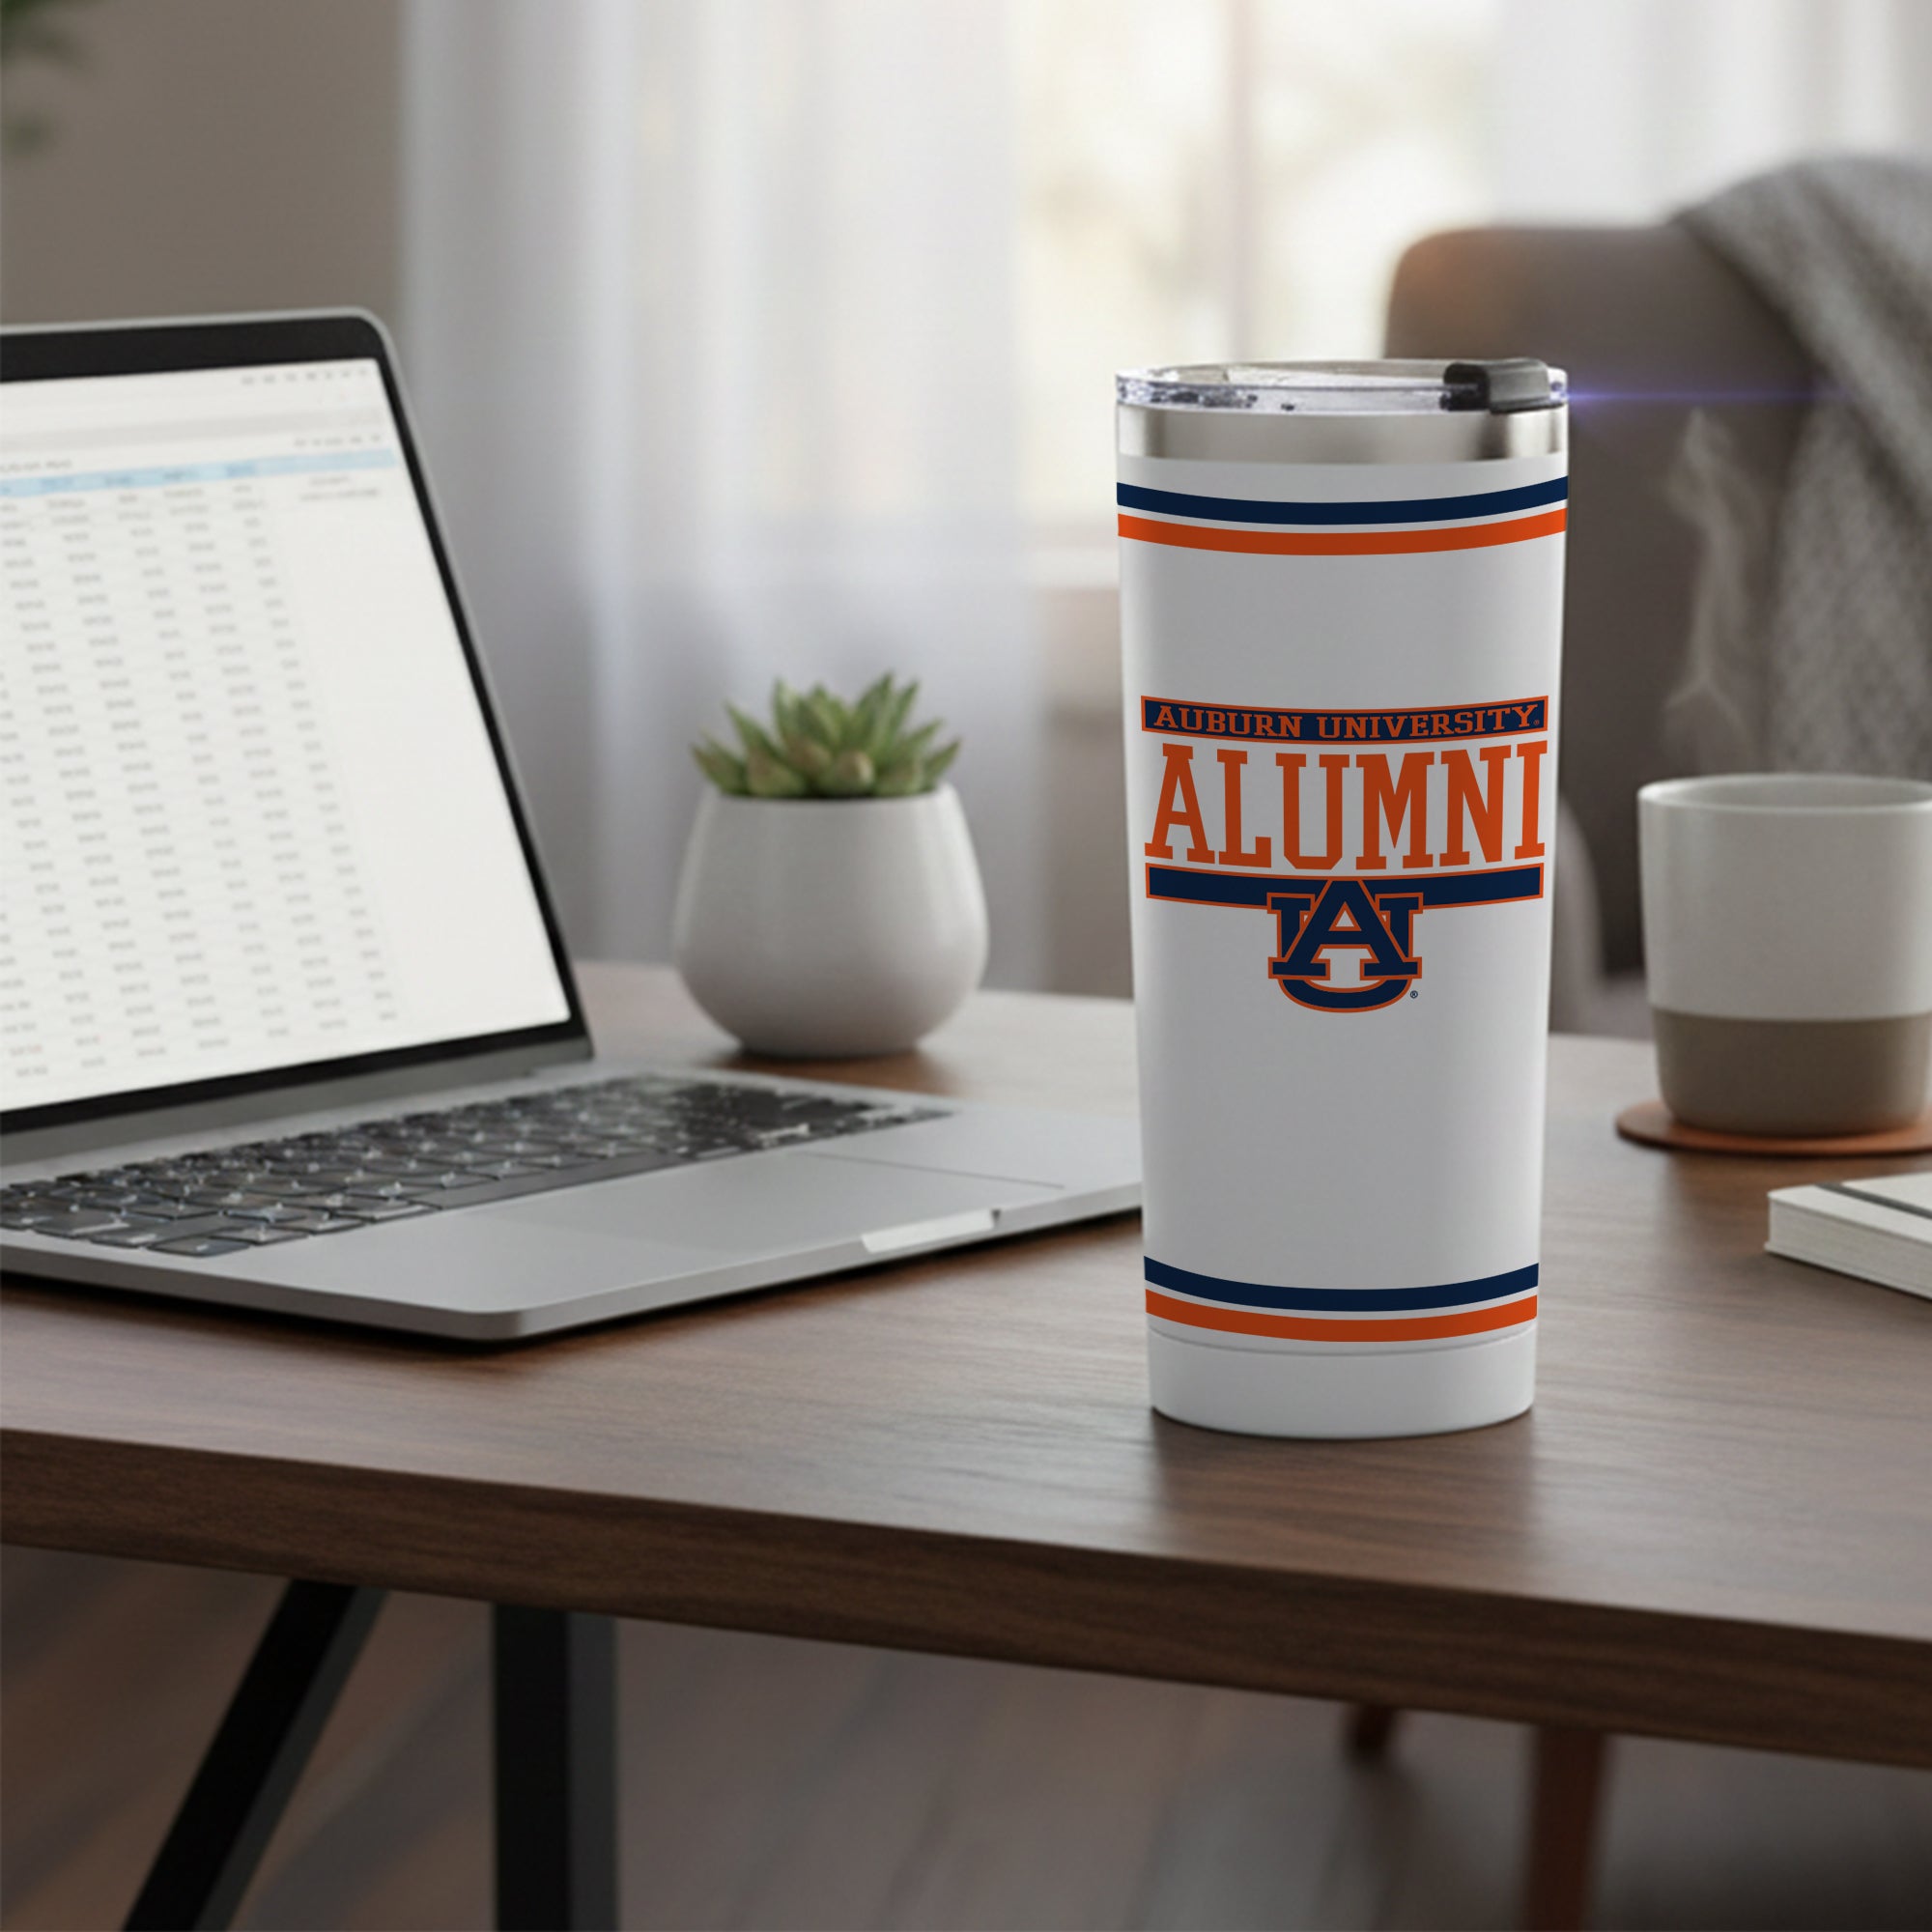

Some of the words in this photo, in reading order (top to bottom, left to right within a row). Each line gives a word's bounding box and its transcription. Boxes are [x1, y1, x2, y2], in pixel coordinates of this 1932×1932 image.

[1153, 705, 1302, 737] AUBURN
[1317, 704, 1539, 739] UNIVERSITY
[1145, 740, 1548, 870] ALUMNI
